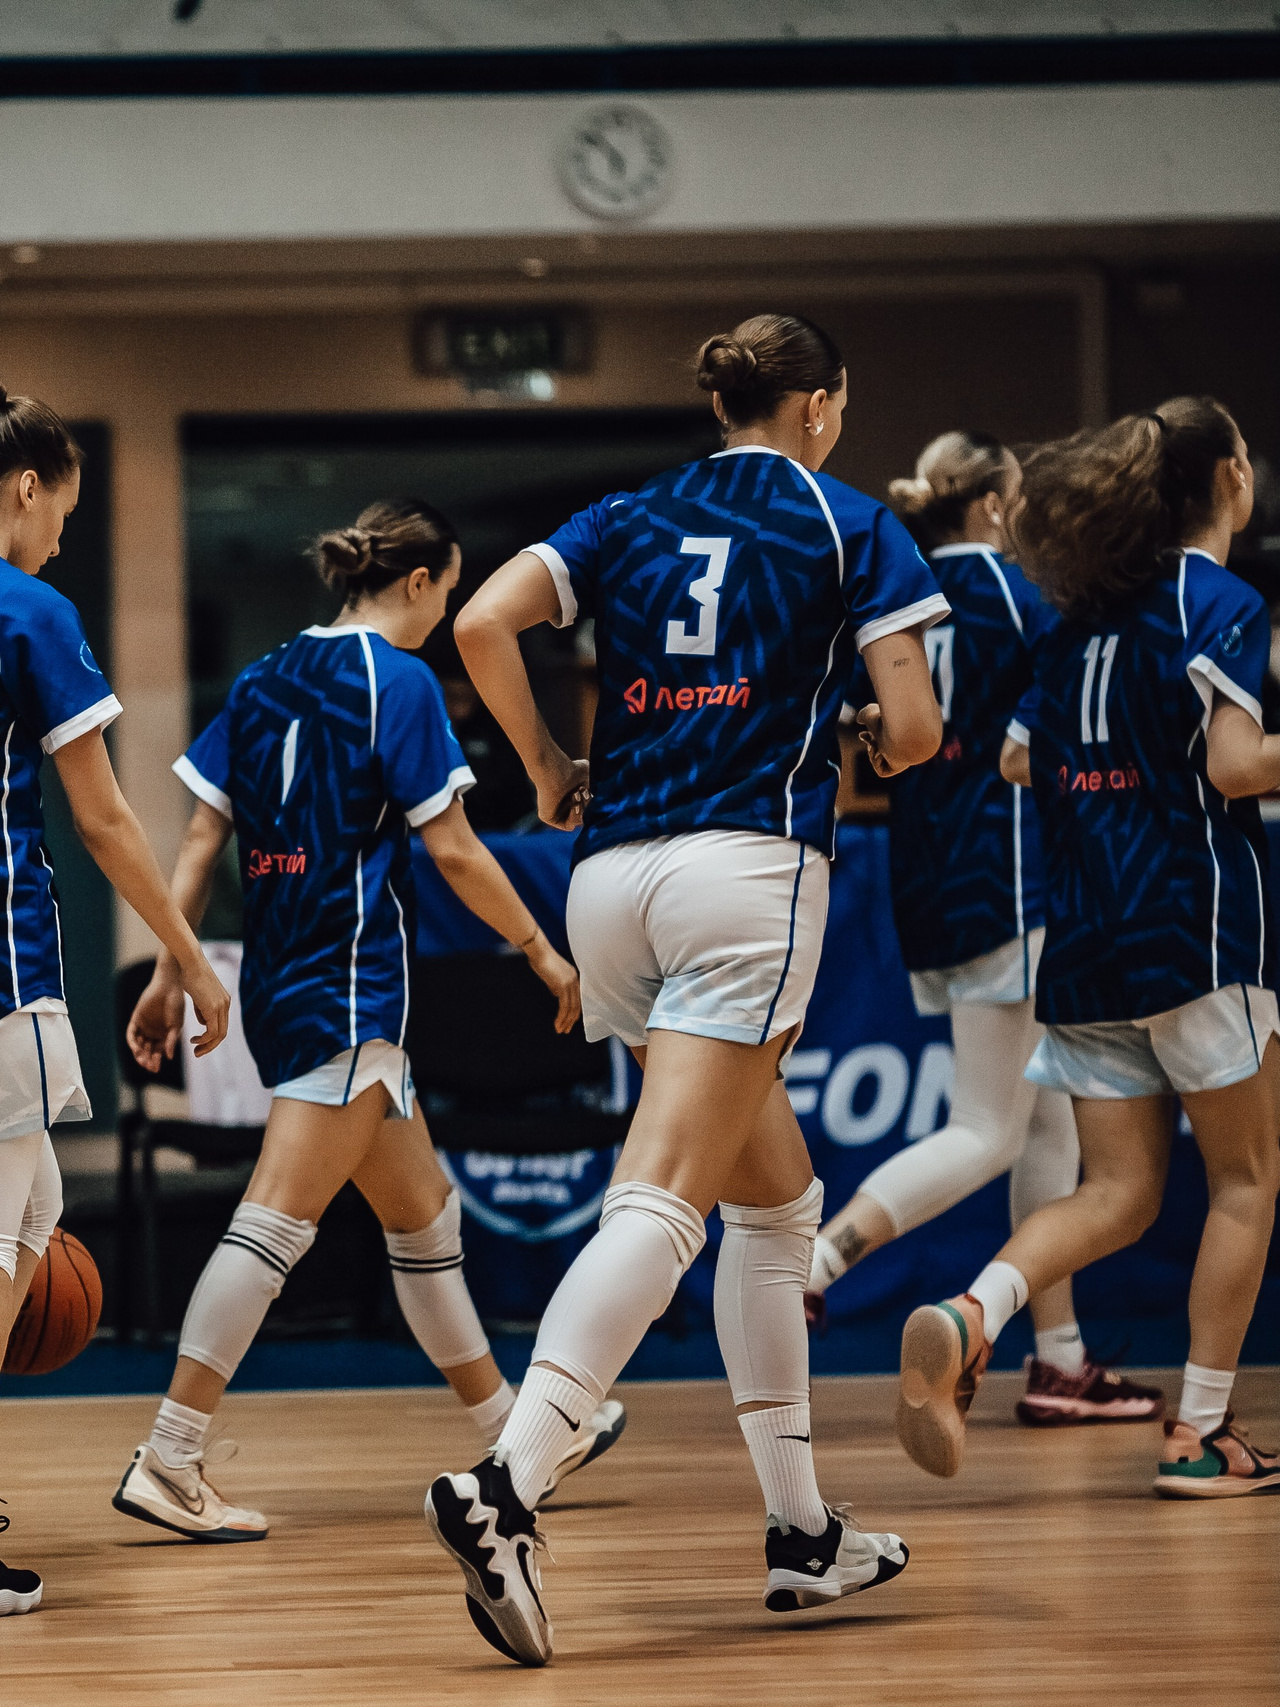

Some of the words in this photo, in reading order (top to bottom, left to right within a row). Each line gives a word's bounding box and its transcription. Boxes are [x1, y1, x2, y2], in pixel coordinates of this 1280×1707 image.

[665, 536, 732, 656] 3
[653, 677, 751, 711] летай
[1081, 635, 1118, 744] 11
